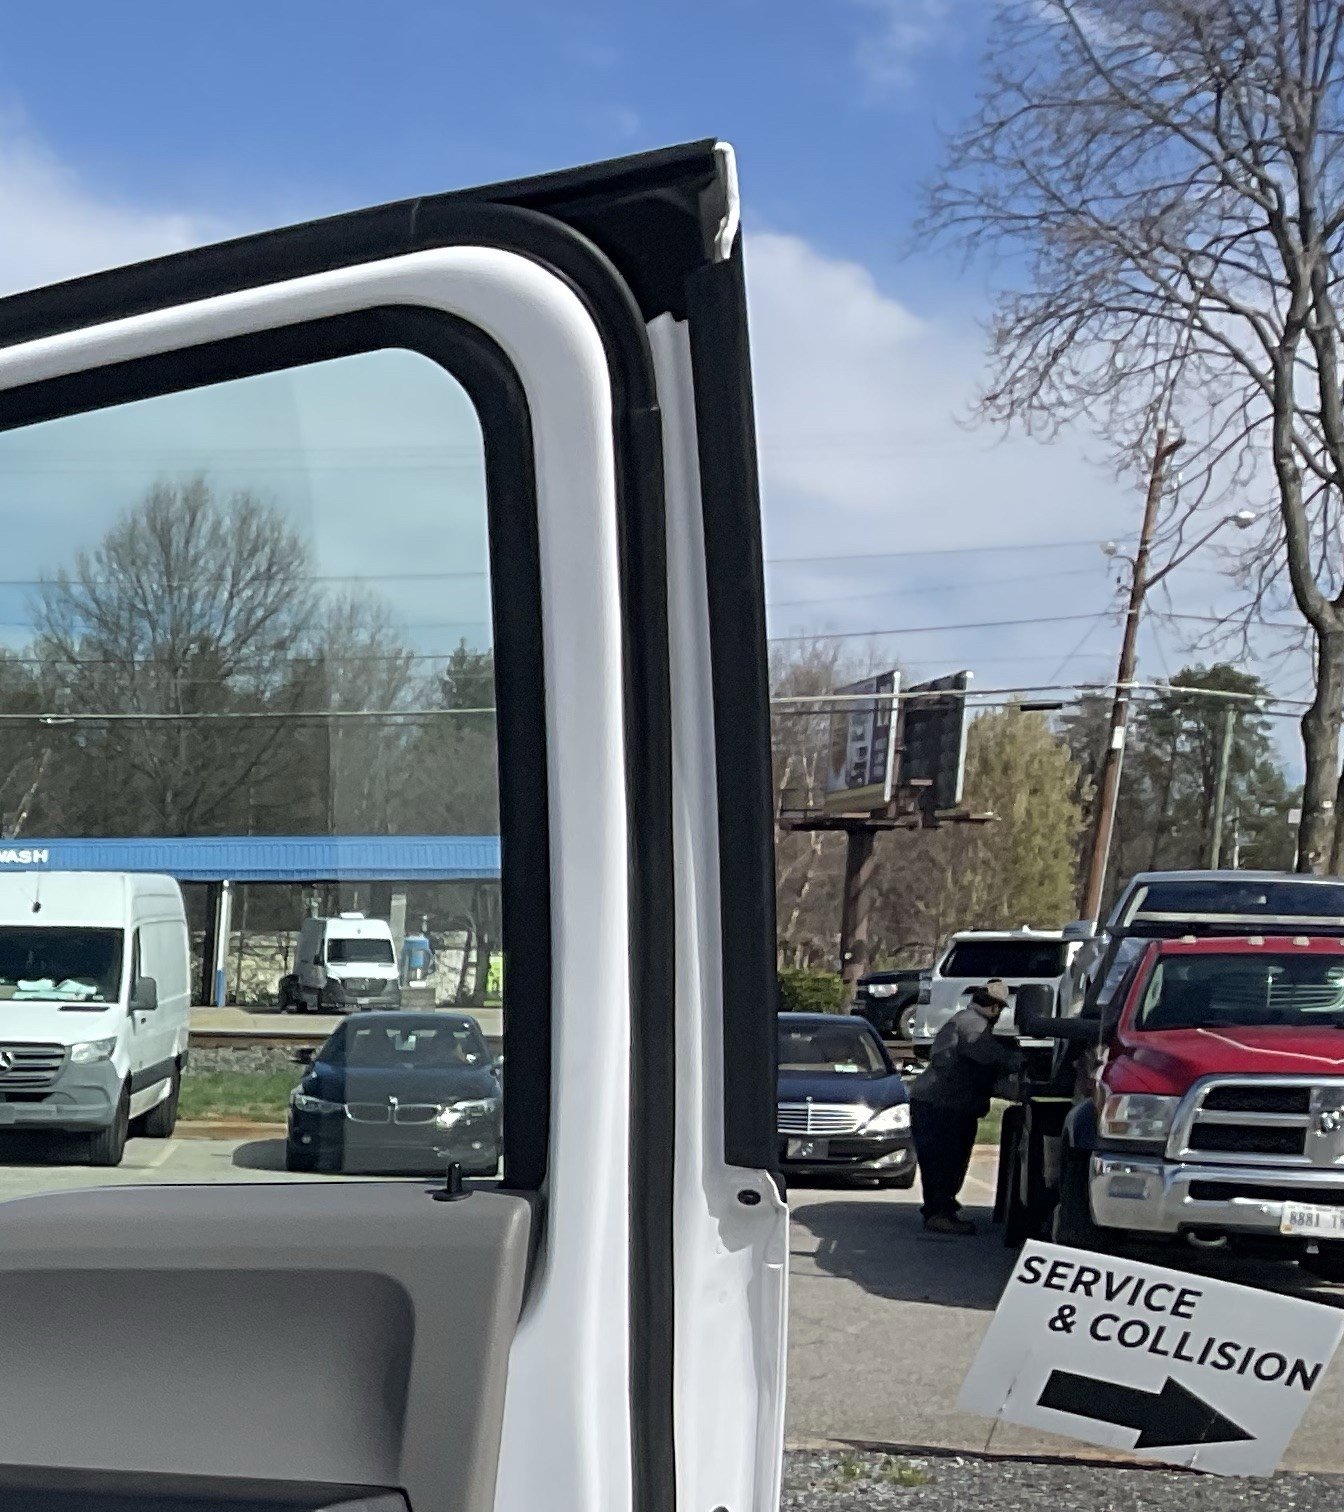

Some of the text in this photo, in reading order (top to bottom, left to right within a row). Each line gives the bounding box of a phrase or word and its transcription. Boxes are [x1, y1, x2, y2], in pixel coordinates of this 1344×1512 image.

[1017, 1255, 1203, 1320] SERVICE
[1047, 1304, 1324, 1392] & COLLISION
